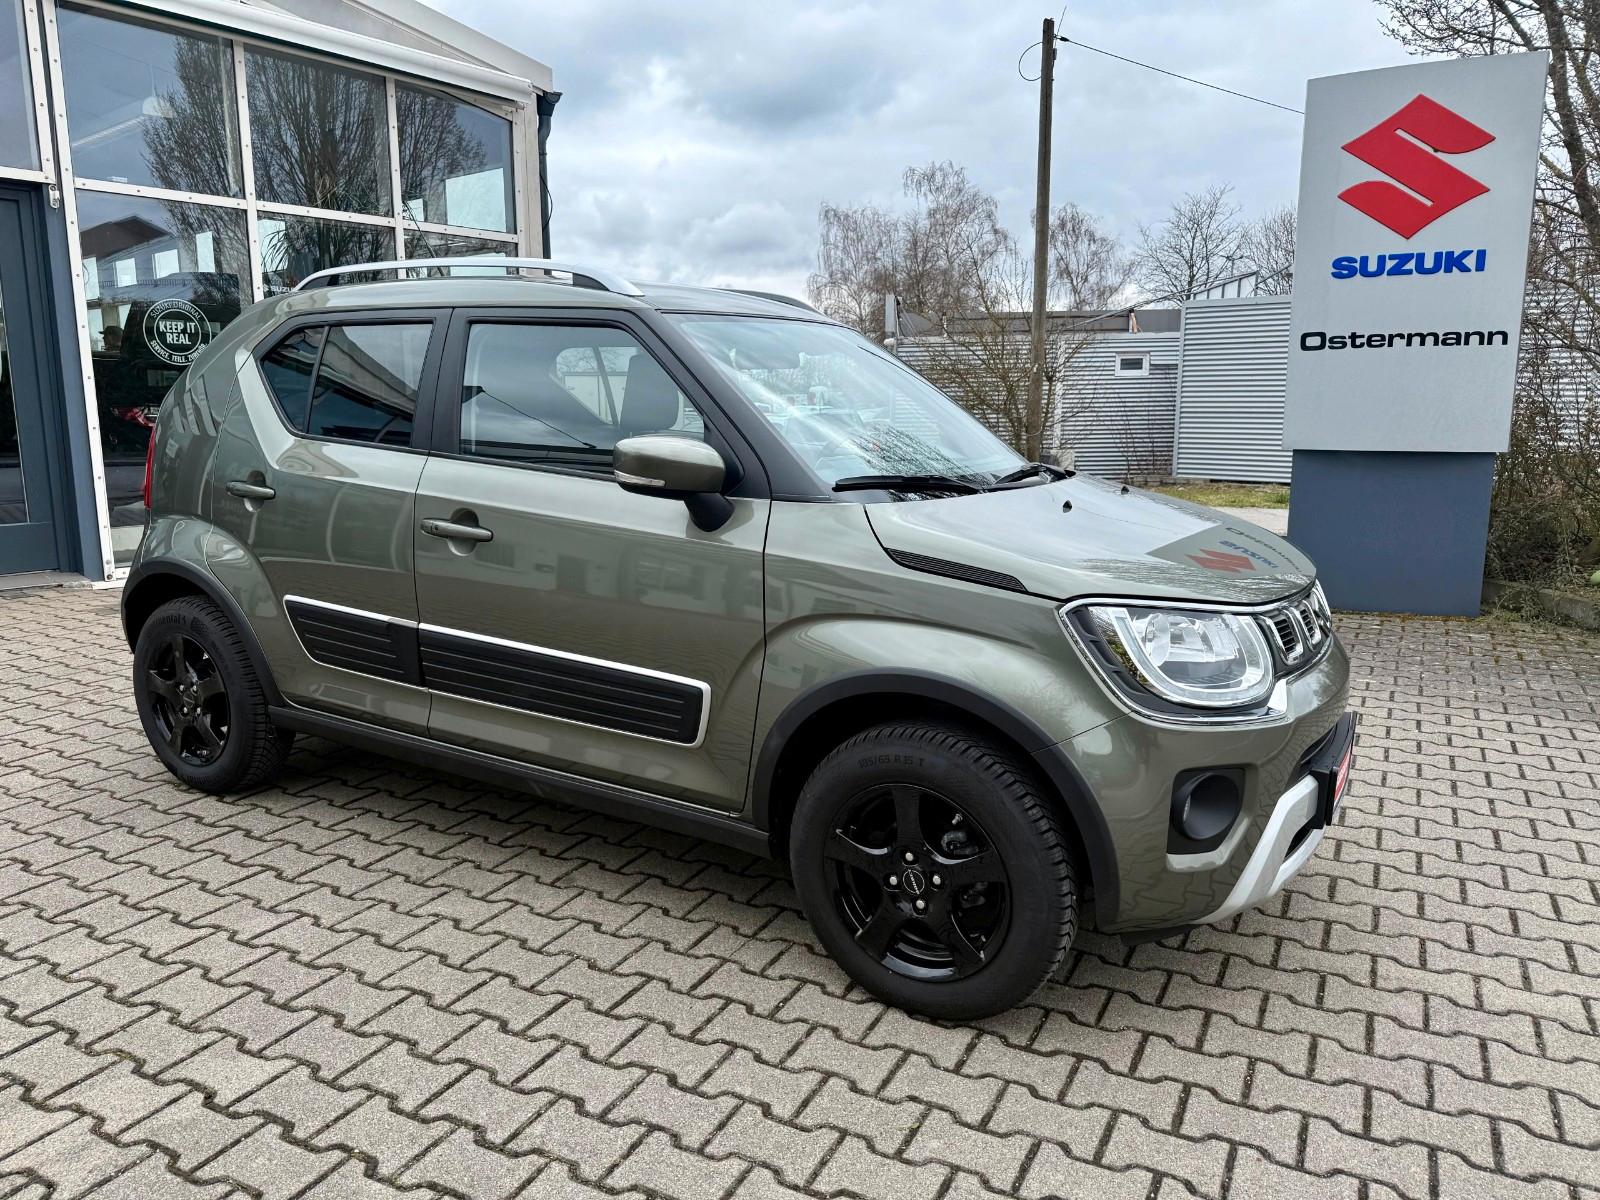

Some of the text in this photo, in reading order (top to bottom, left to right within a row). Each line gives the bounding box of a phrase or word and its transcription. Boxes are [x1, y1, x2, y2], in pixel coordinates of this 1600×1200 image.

[1331, 248, 1487, 279] SUZUKI
[159, 321, 196, 334] KEEP IT
[166, 333, 192, 345] REAL
[1300, 329, 1508, 352] Ostermann
